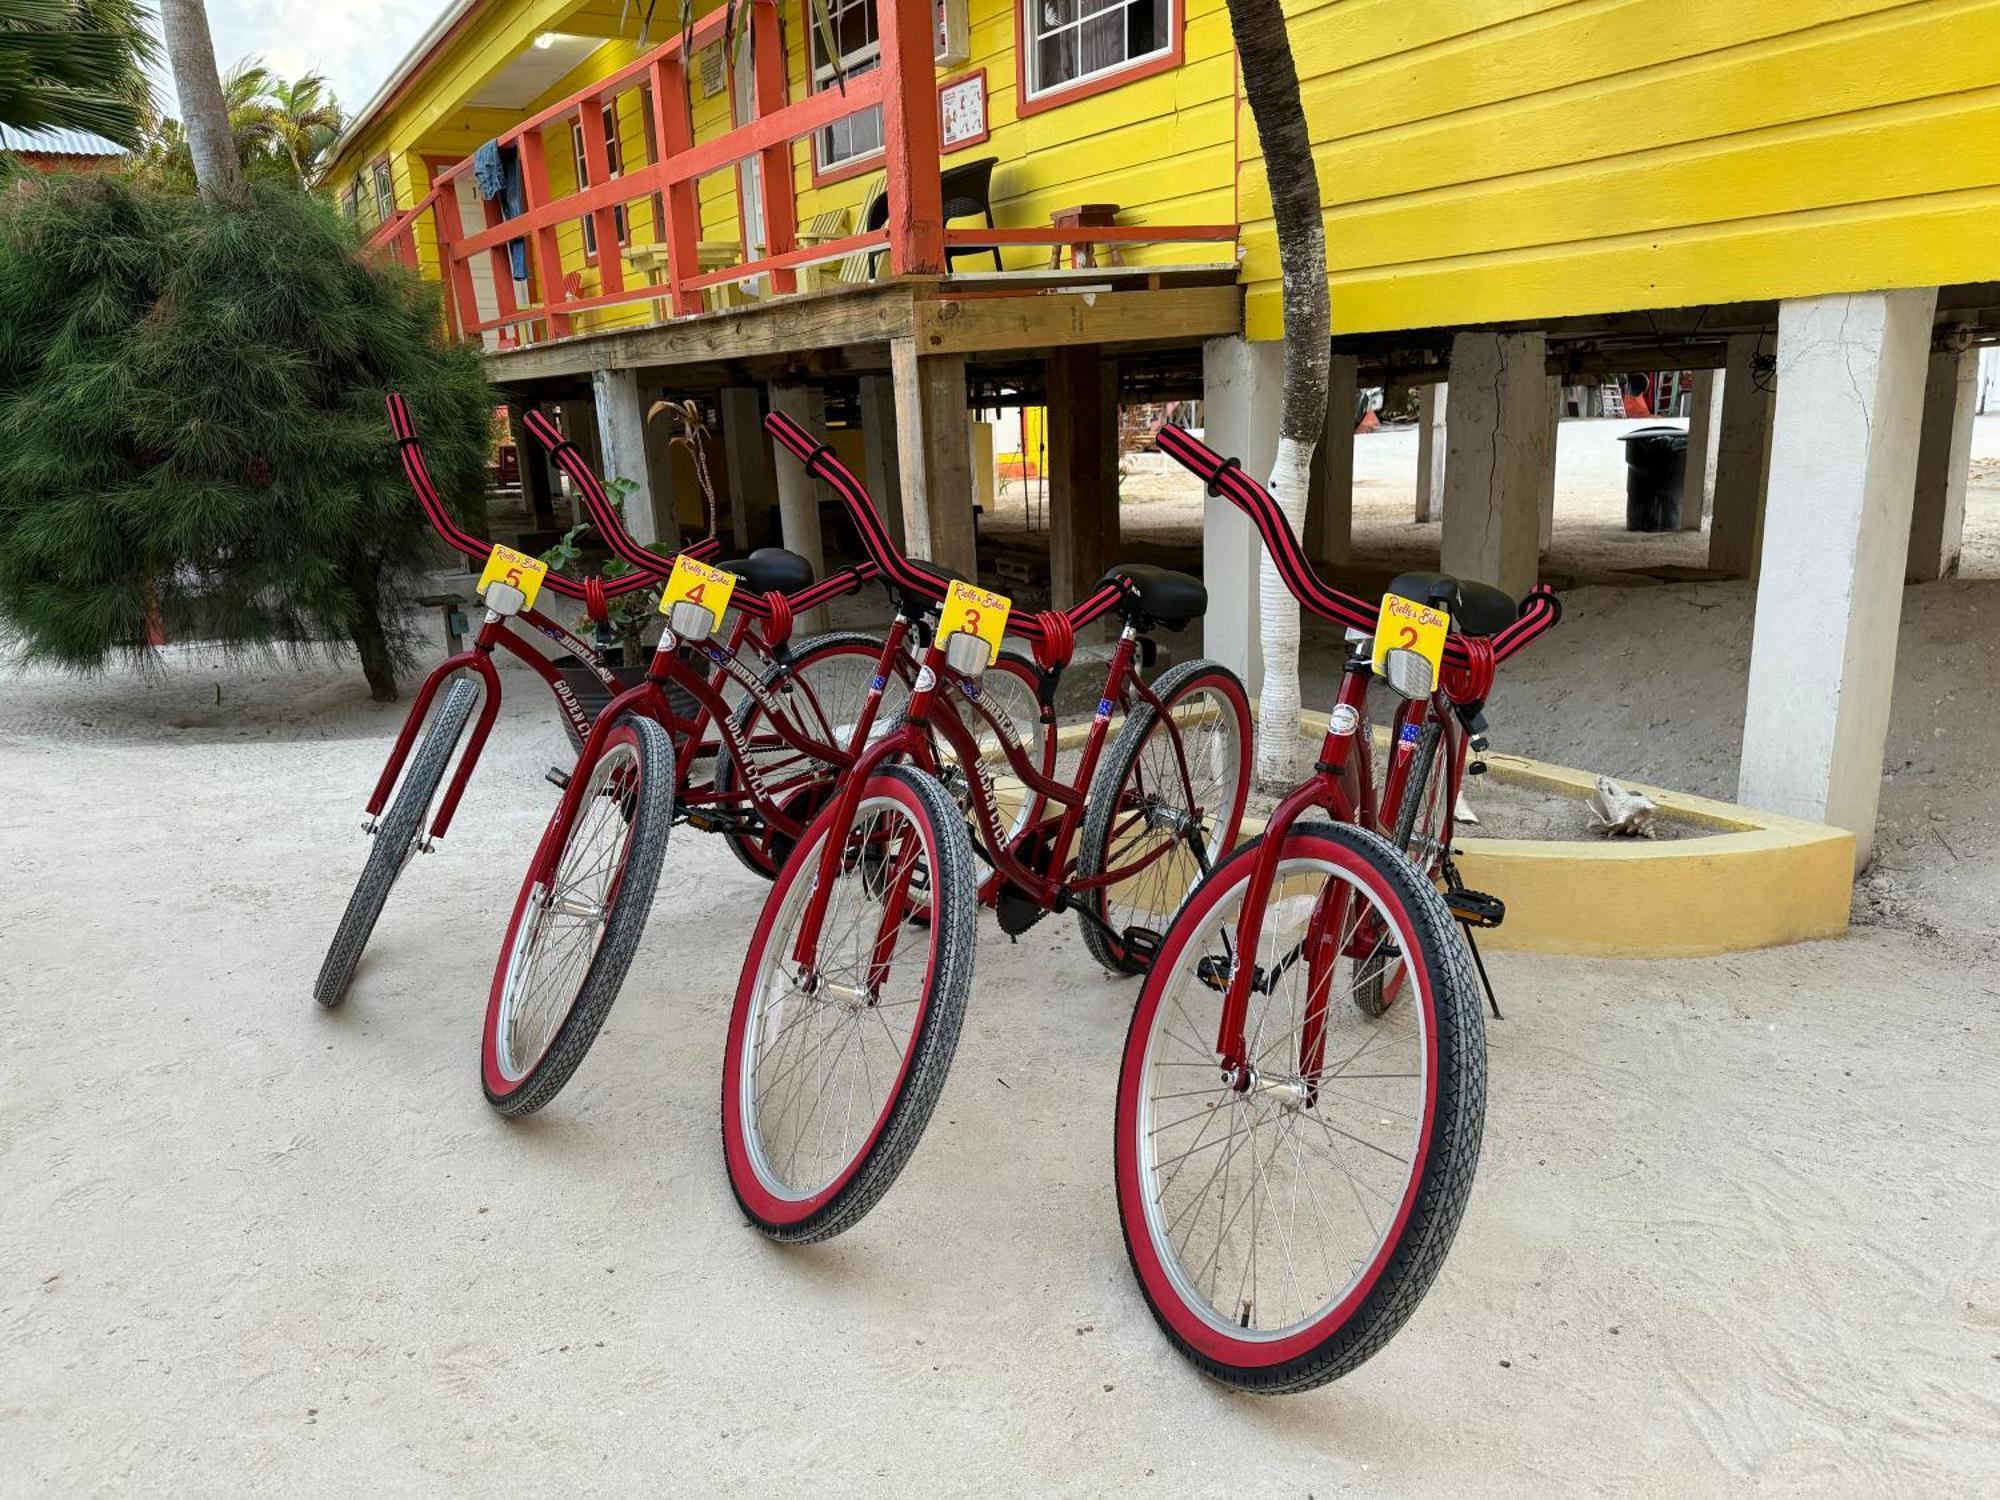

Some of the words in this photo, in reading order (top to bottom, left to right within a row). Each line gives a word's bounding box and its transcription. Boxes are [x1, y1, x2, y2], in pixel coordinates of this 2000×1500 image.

[506, 567, 523, 588] 5
[685, 583, 705, 604] 4
[961, 608, 980, 636] 3
[1418, 607, 1443, 627] Bikes
[1400, 626, 1418, 650] 2
[554, 679, 585, 722] GOLDEN
[728, 656, 779, 714] HURRICANE
[979, 690, 1020, 750] HURRICANE
[724, 714, 754, 764] GOLDEN
[745, 764, 769, 802] CYCLE
[974, 757, 997, 811] GOLDEN
[990, 809, 1008, 852] CYCLE
